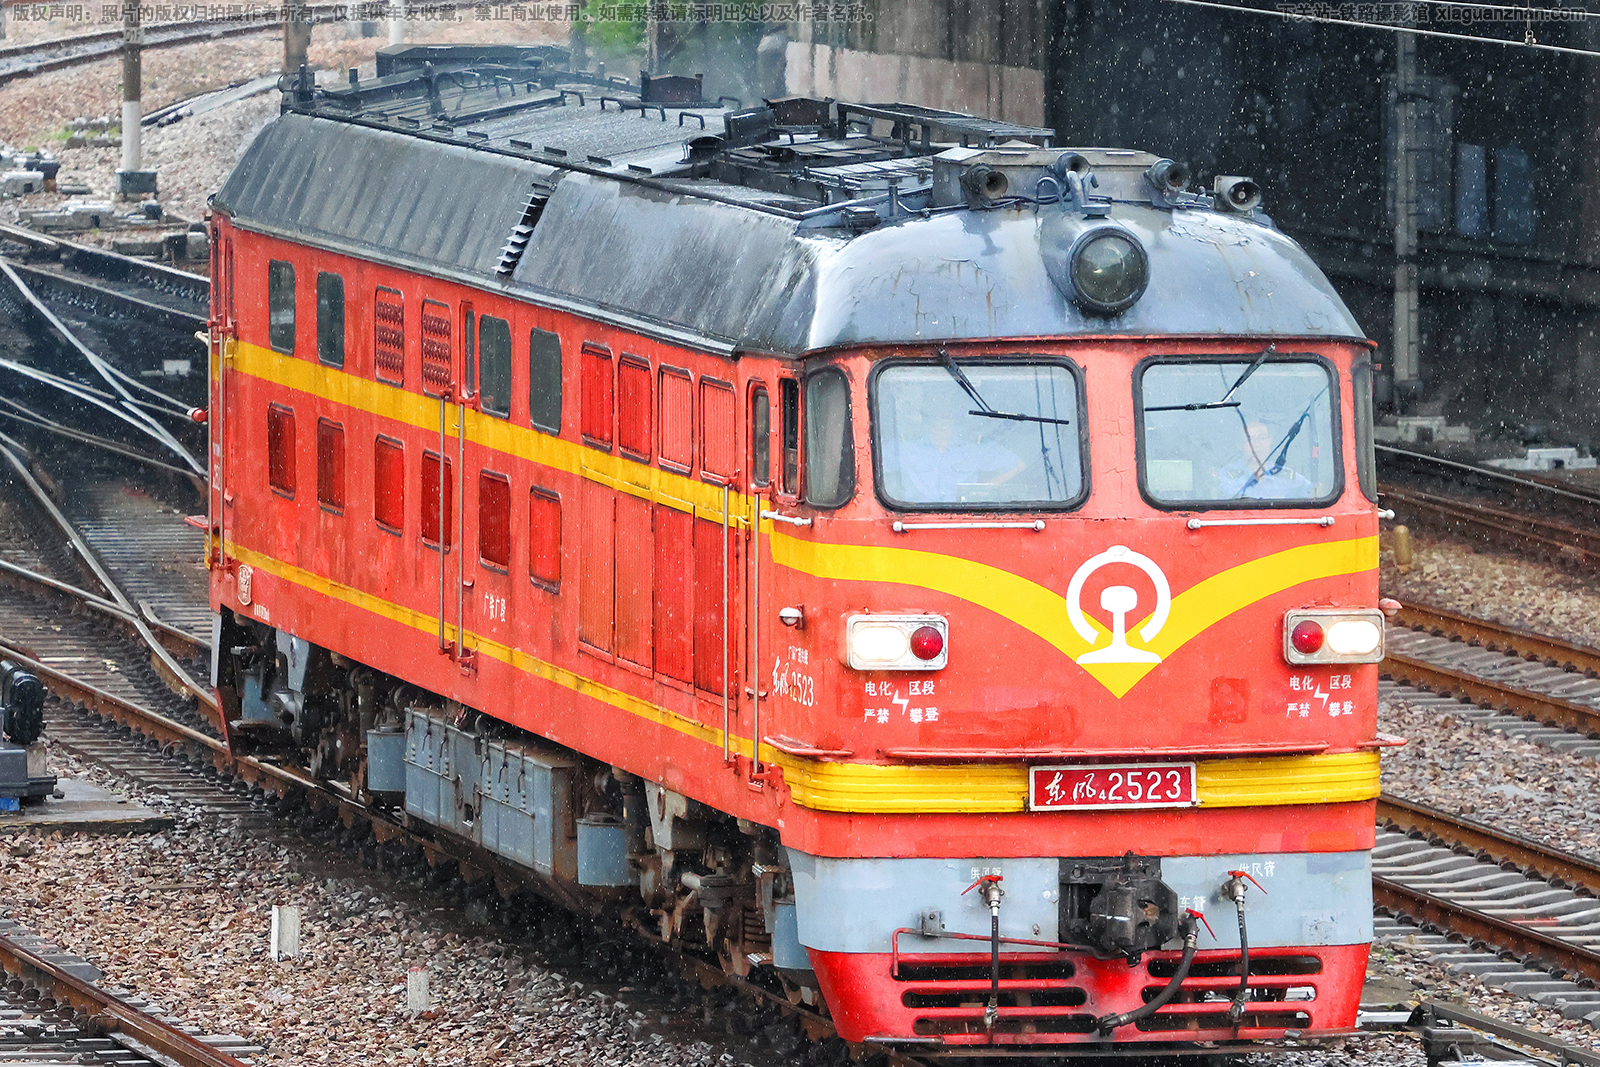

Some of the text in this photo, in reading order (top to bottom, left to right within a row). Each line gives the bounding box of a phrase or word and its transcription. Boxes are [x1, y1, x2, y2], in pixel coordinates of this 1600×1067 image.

[865, 681, 935, 697] 电化 区段
[1289, 674, 1352, 691] 电化 区段
[864, 706, 939, 724] 严禁 攀登
[1286, 700, 1354, 718] 严禁 攀登
[1238, 860, 1276, 878] 供风管
[1179, 894, 1207, 911] 车管
